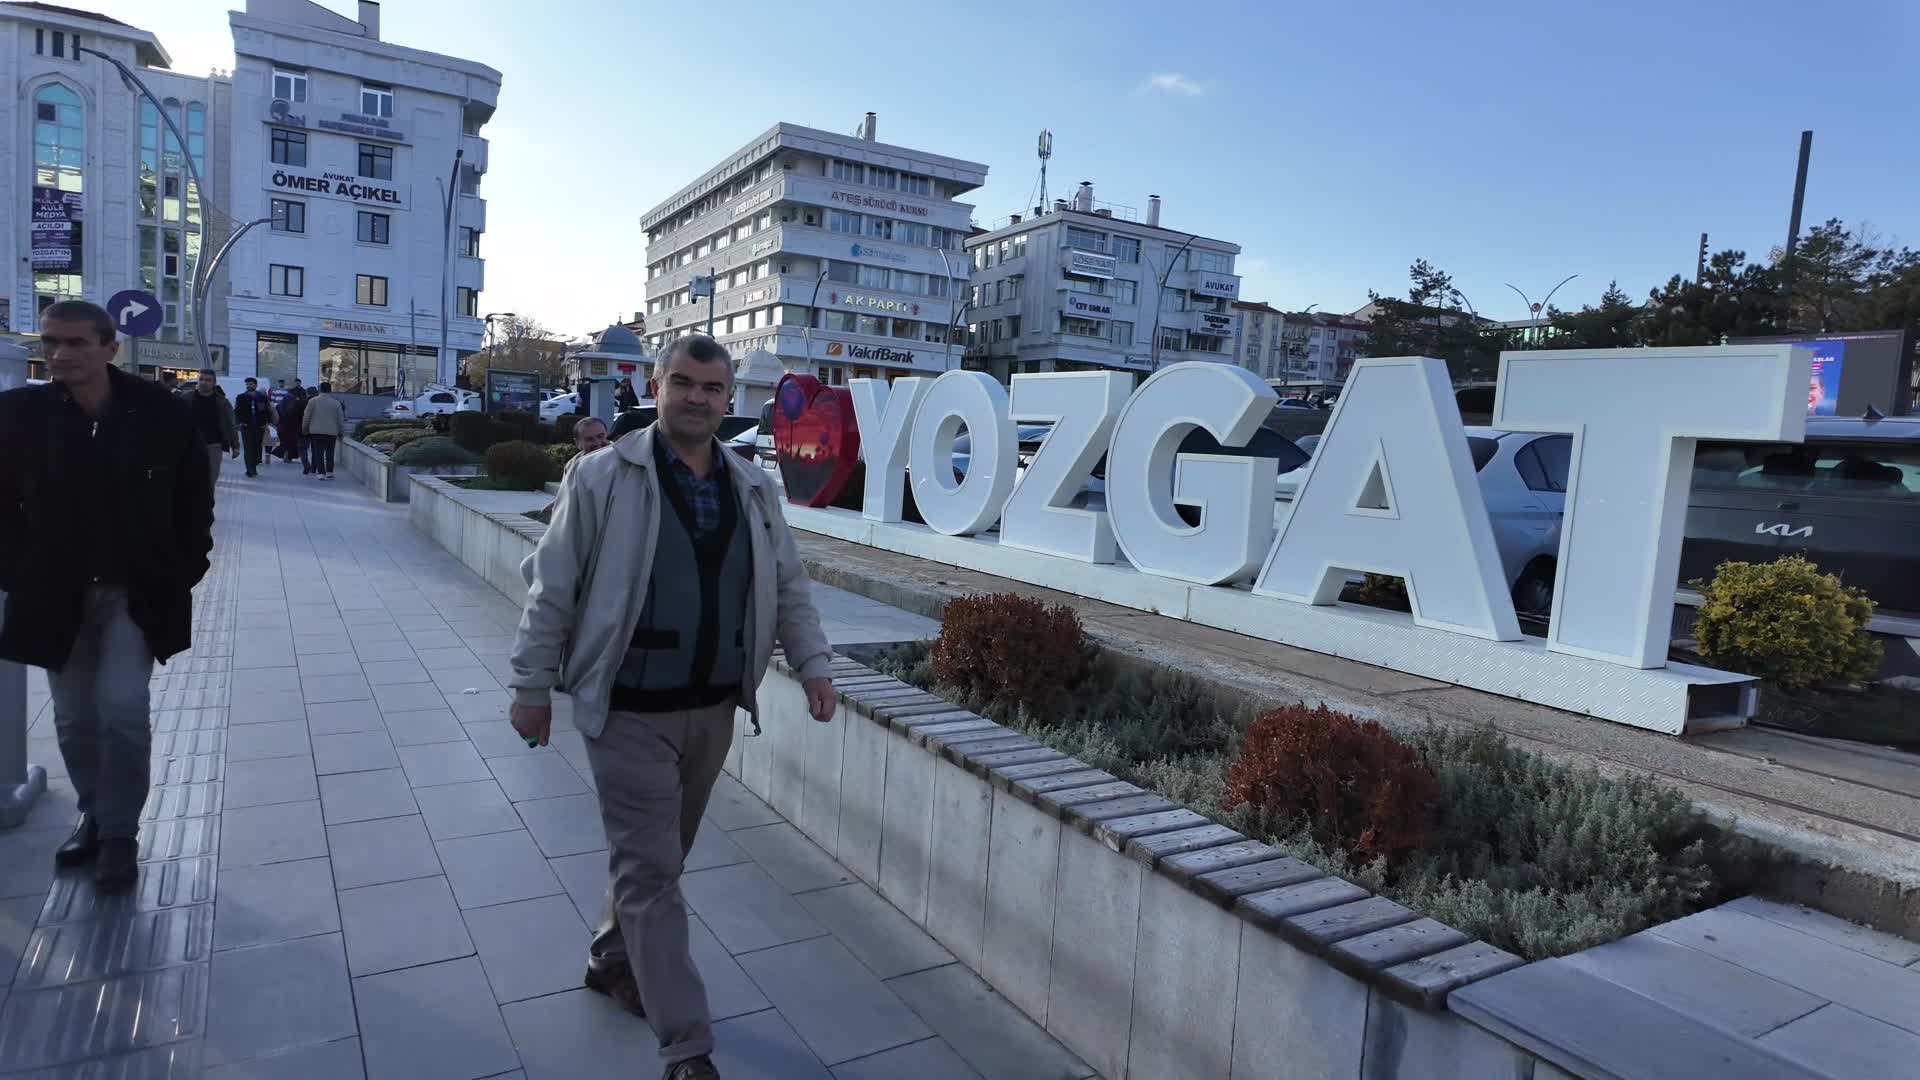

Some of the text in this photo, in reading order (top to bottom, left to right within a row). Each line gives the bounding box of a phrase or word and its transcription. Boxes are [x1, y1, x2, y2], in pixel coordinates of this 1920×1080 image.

[323, 172, 355, 183] AVUKAT
[272, 170, 402, 204] ÖMER AÇIKEL
[1204, 281, 1234, 292] AVUKAT
[845, 295, 864, 305] AK
[848, 344, 915, 364] VakıfBank
[848, 343, 1811, 669] YOZGAT
